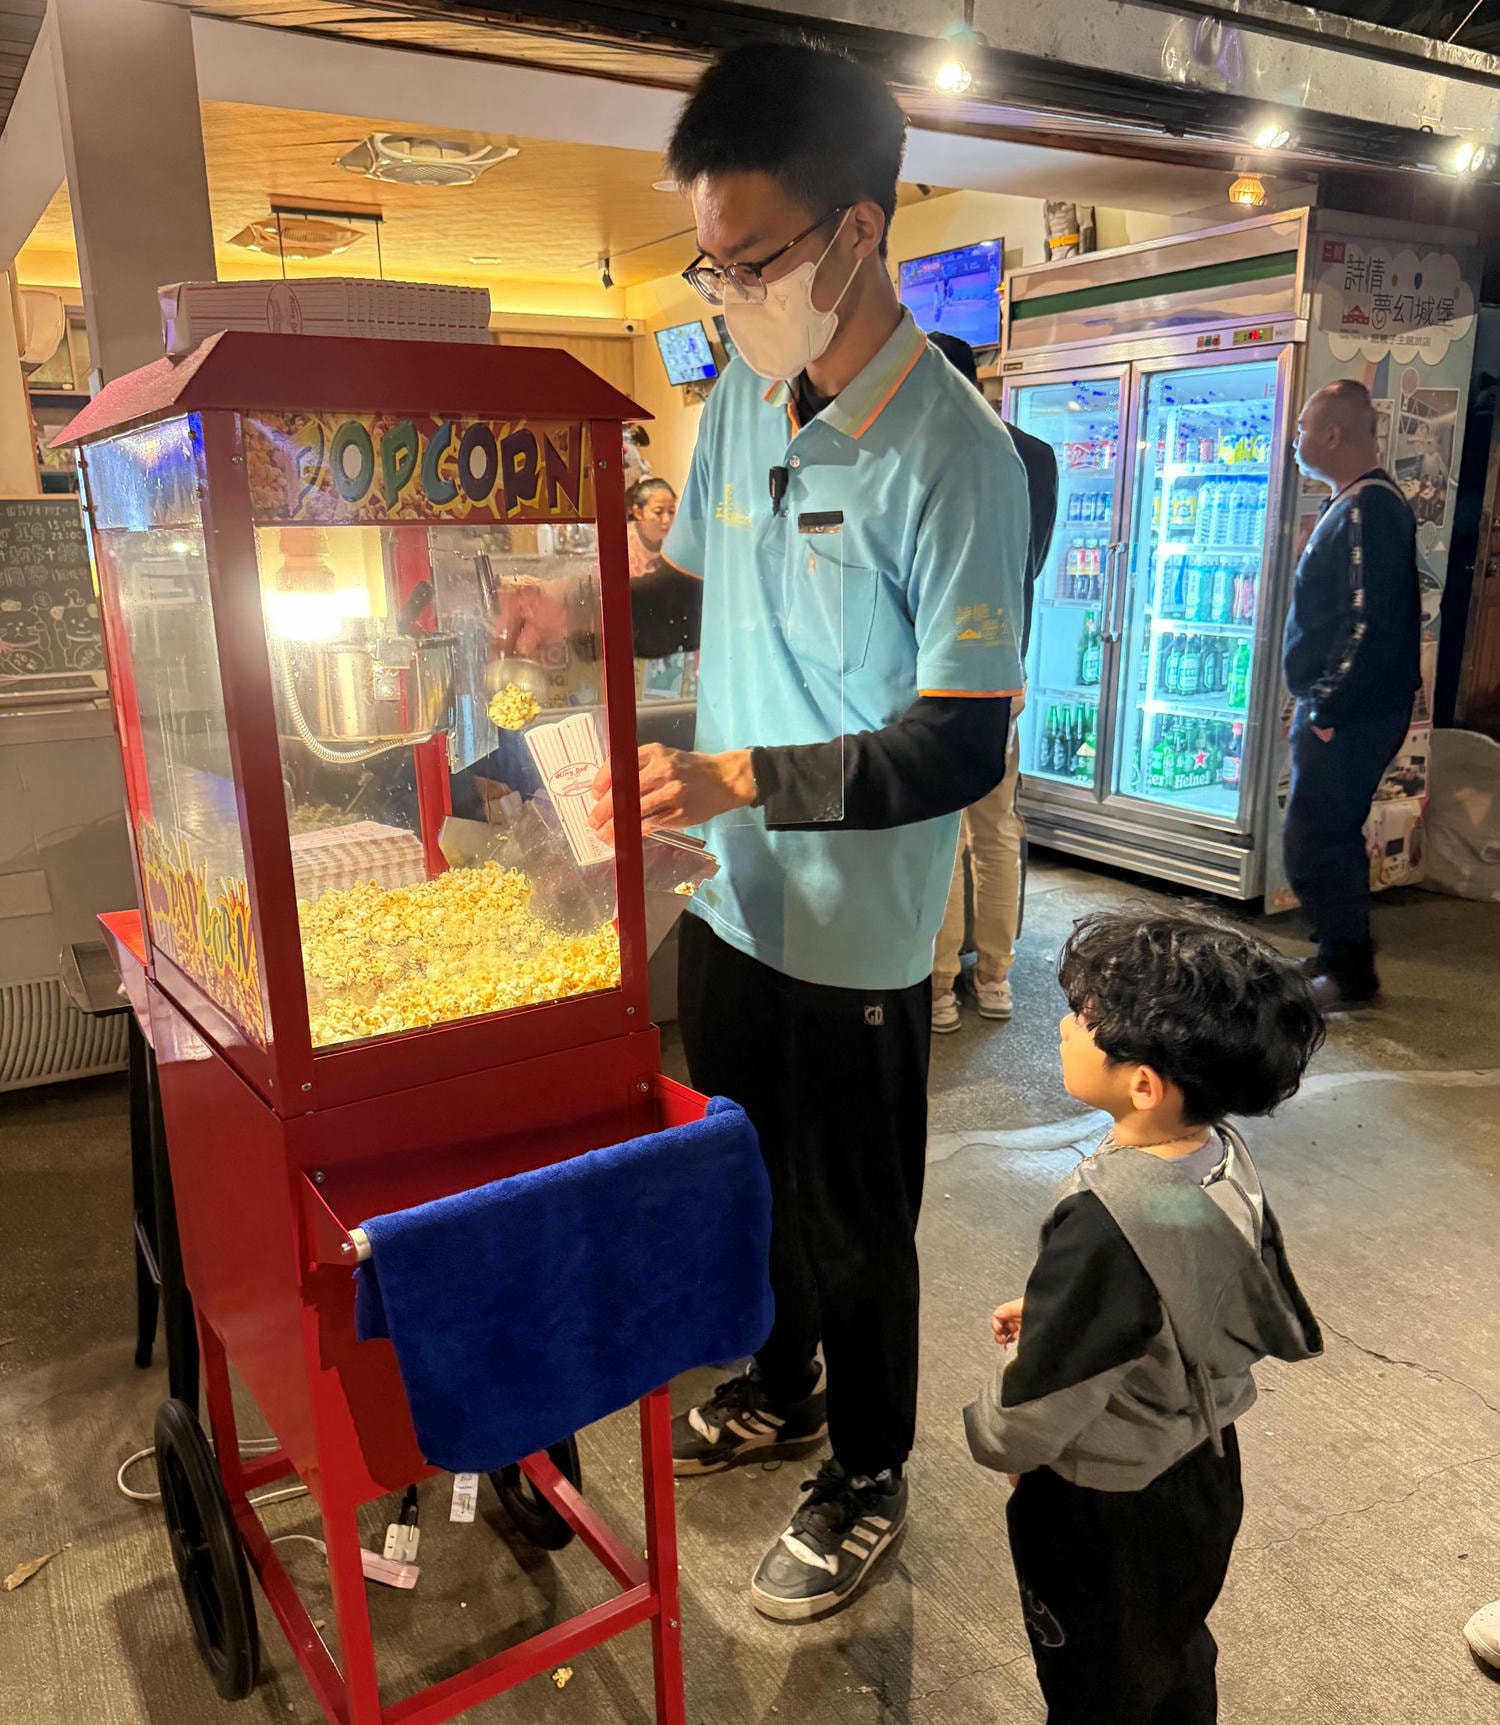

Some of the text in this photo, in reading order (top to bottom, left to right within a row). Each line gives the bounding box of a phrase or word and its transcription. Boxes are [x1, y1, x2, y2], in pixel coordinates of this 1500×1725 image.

[1344, 254, 1385, 293] 詩情
[1371, 294, 1455, 330] 夢幻城堡
[286, 418, 584, 519] POPCORN
